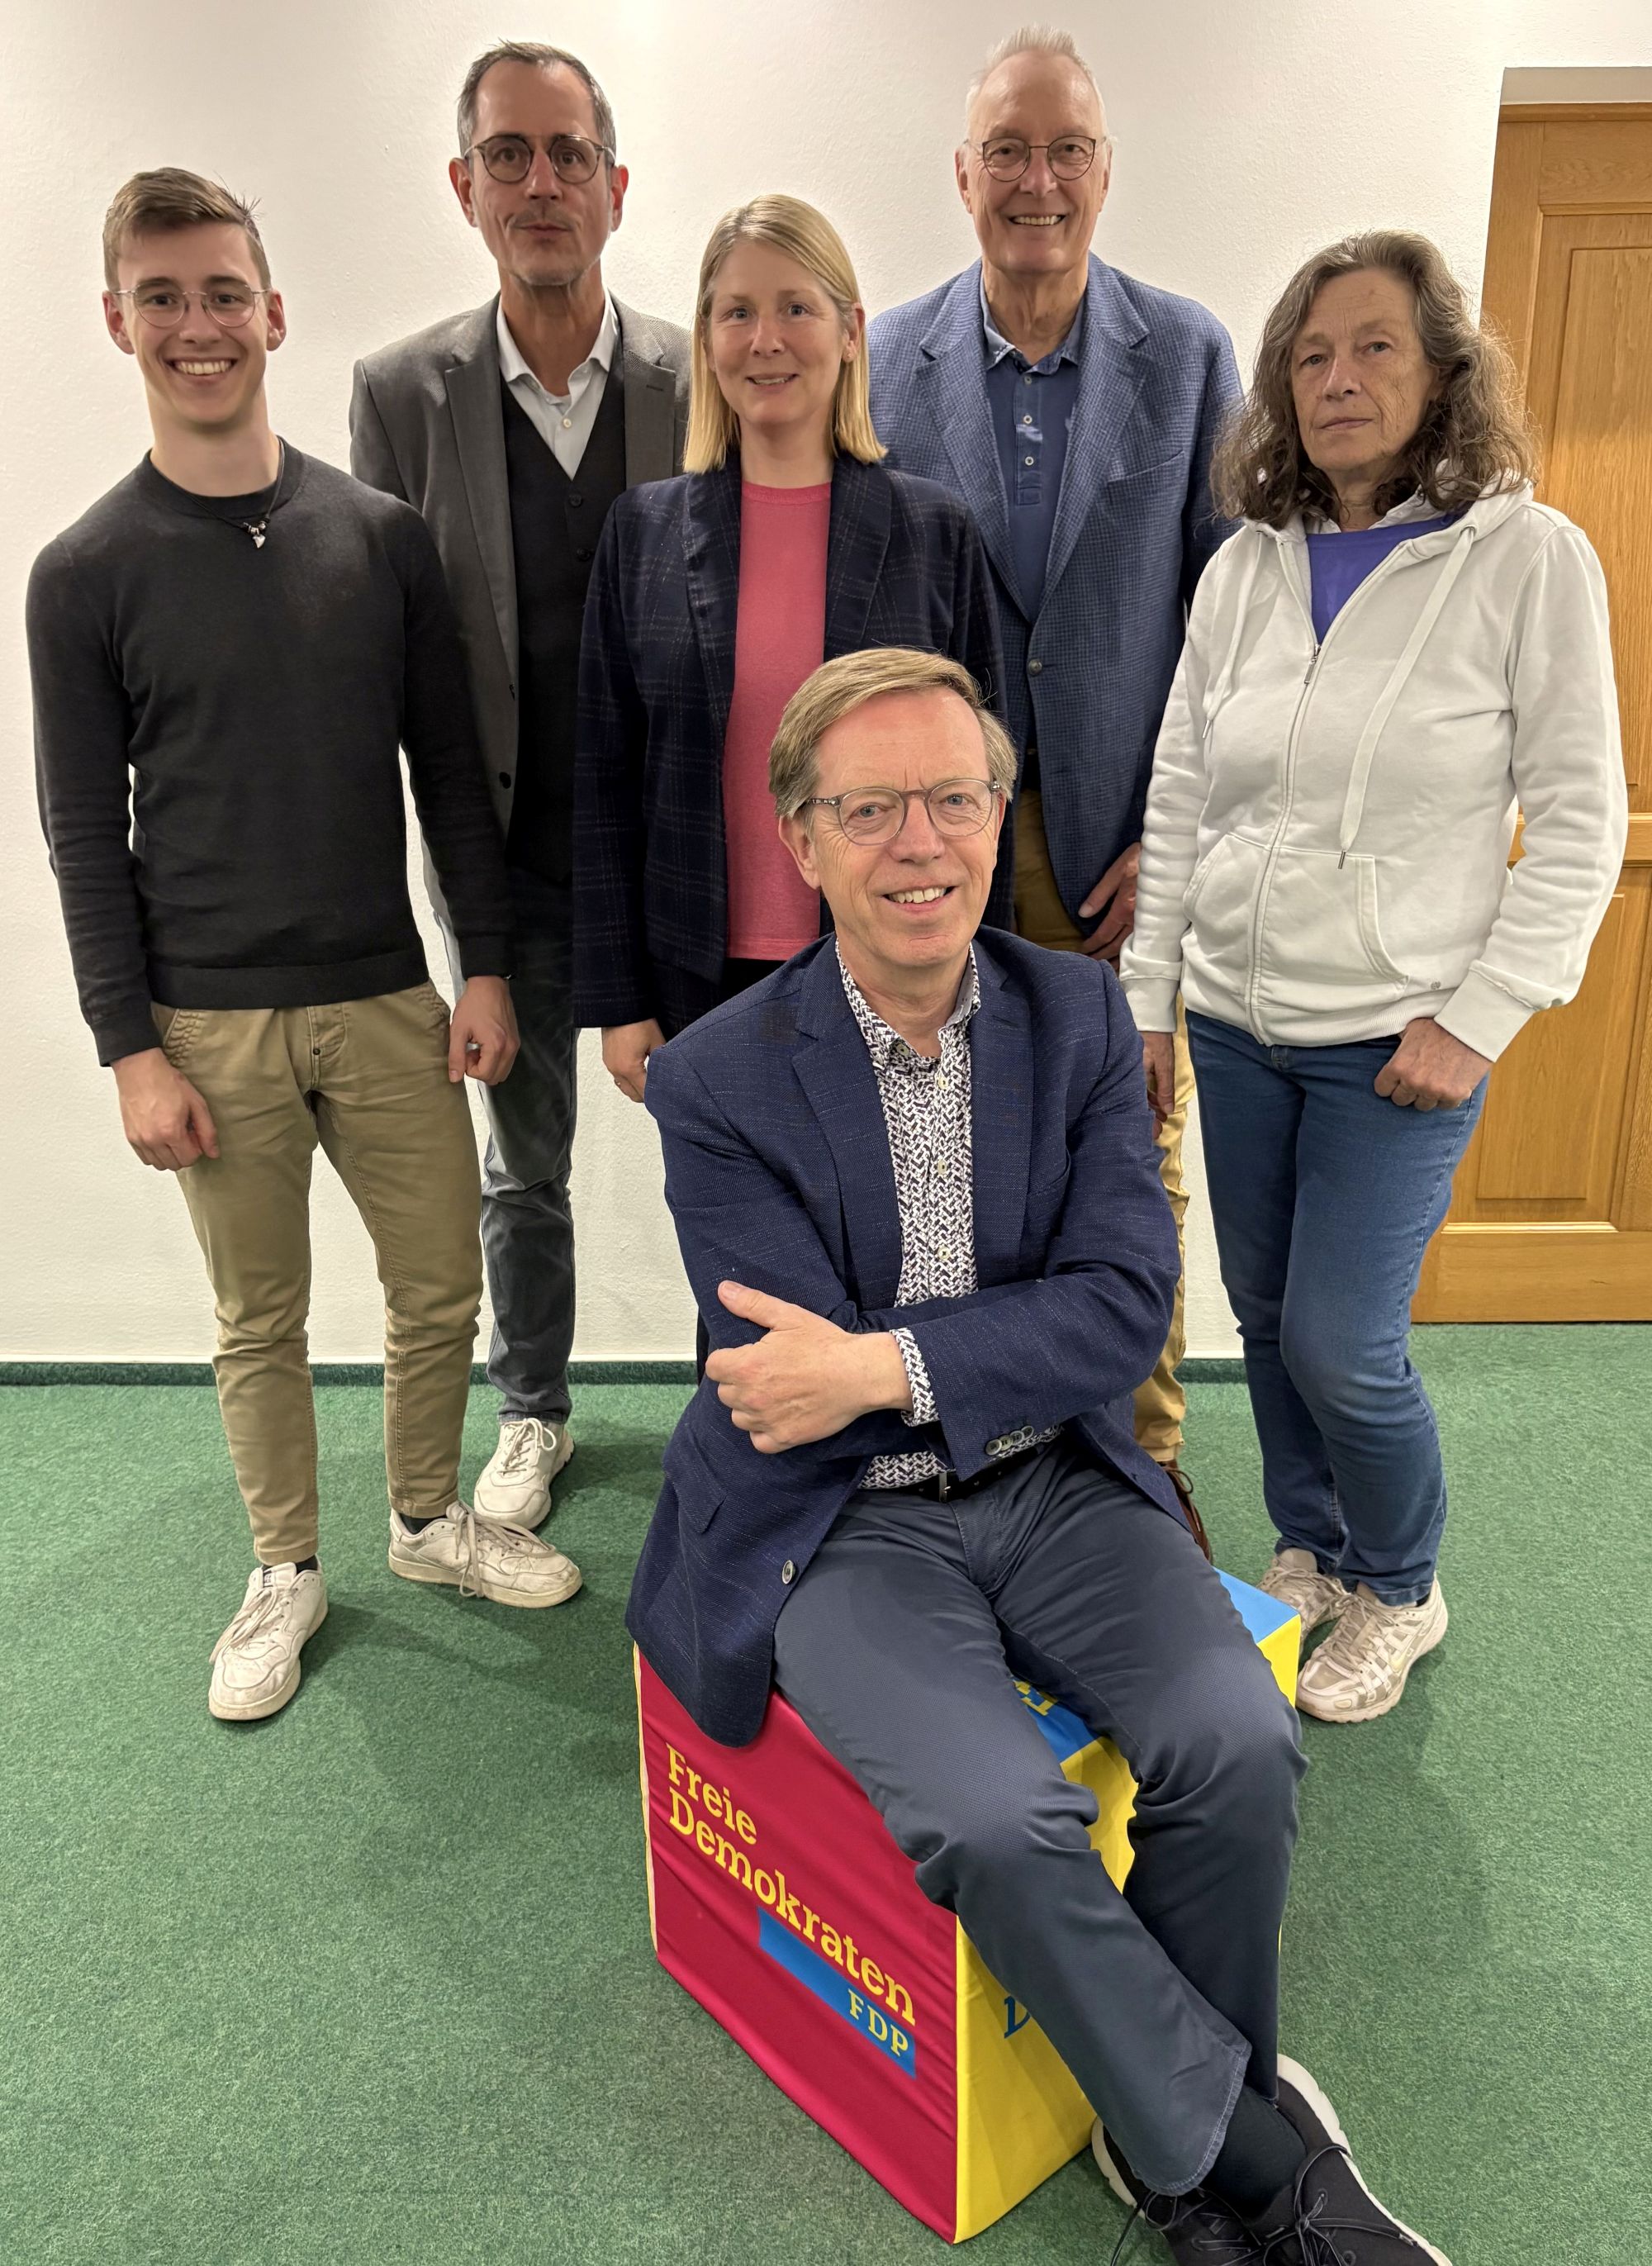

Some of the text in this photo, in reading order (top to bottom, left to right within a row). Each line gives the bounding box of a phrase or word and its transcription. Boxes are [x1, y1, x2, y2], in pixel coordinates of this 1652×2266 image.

[666, 1742, 757, 1845] Freie
[669, 1786, 915, 2026] Demokraten
[847, 1988, 909, 2057] FDP
